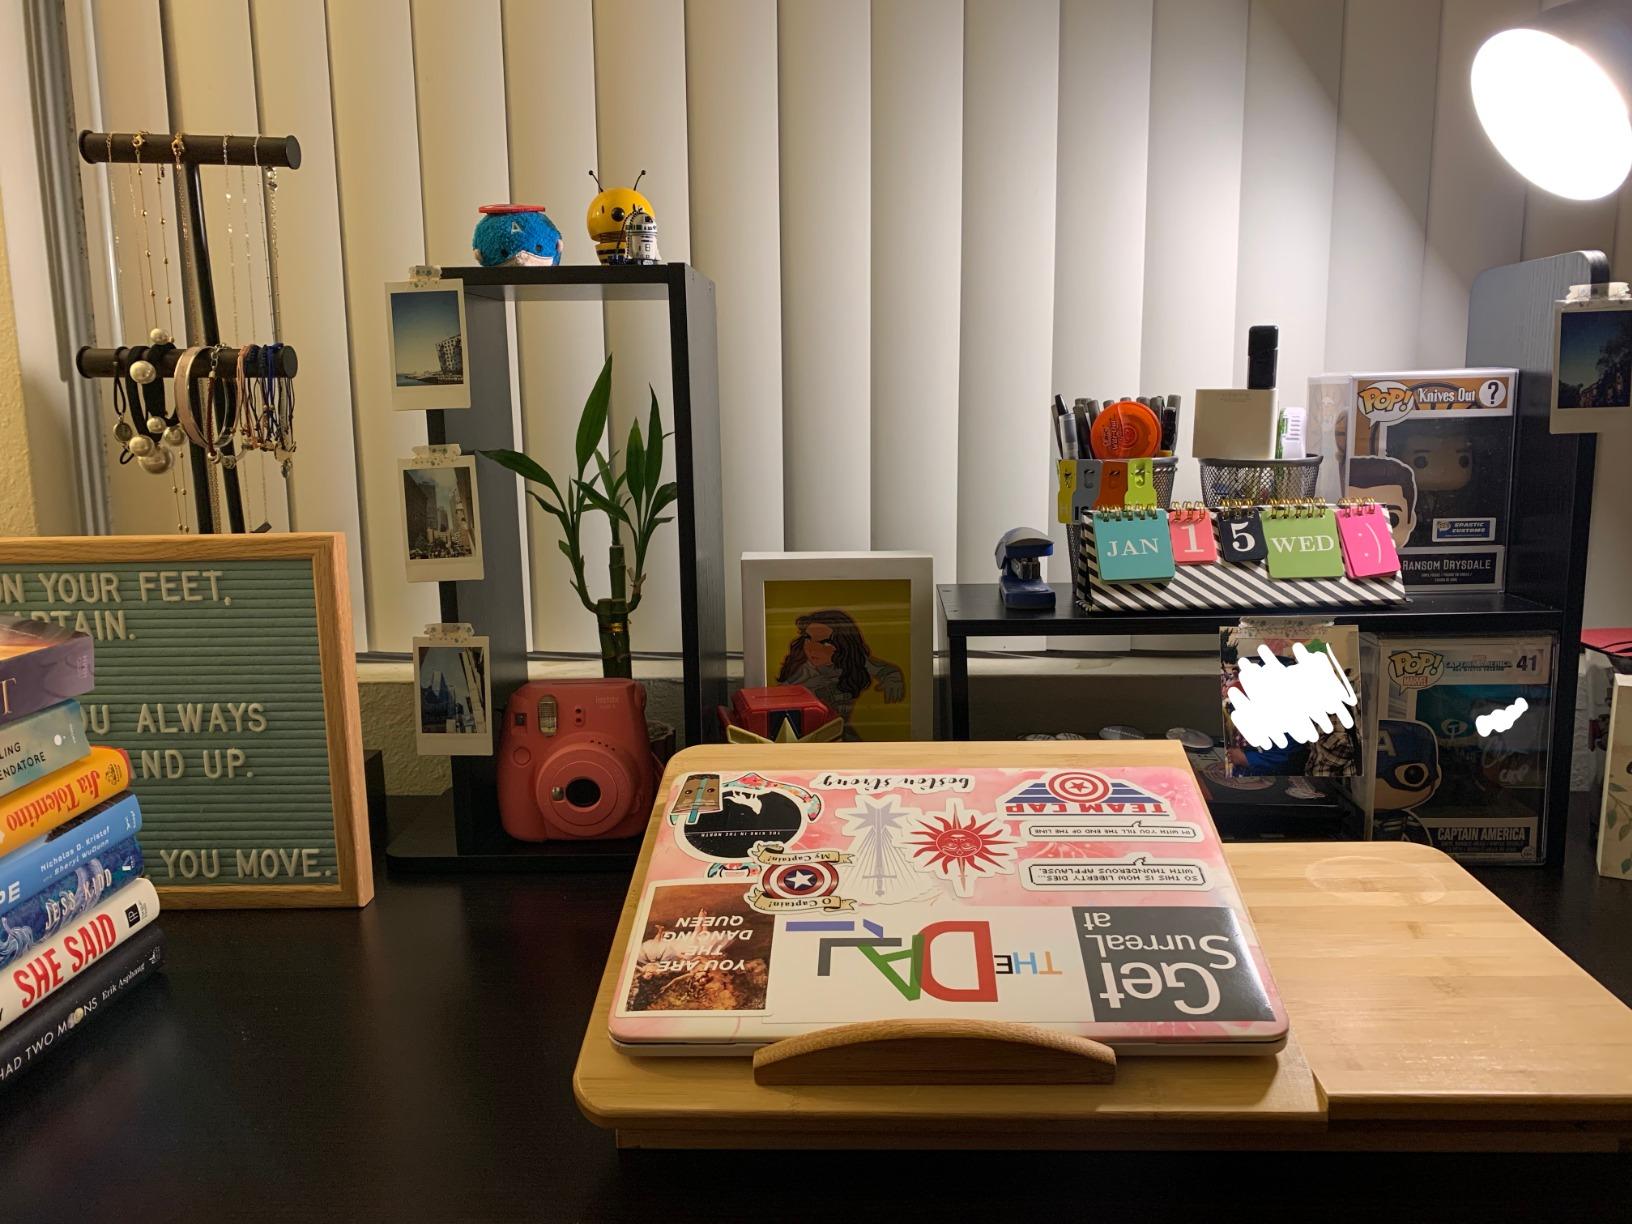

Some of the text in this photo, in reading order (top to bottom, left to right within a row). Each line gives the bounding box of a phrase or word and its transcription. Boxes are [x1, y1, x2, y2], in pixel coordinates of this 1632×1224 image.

[1358, 387, 1413, 415] POP!
[1418, 388, 1455, 402] Knives
[1458, 388, 1476, 402] Out
[1107, 538, 1159, 557] JAN
[1180, 524, 1205, 553] 1
[1230, 521, 1256, 552] 5
[1271, 535, 1335, 553] WED
[1402, 559, 1491, 571] RANSOM DRYSDALE
[0, 569, 232, 606] N YOUR FEET.
[1388, 651, 1444, 678] POP!
[1516, 655, 1537, 671] 41
[137, 703, 267, 733] ALWAYS
[131, 749, 186, 780] ND
[203, 747, 254, 780] UP.
[76, 770, 101, 799] Jia
[821, 775, 969, 791] boston strong
[6, 783, 80, 831] Tolentino
[1005, 803, 1167, 813] TEAM CAP
[1437, 827, 1526, 841] CAPTAIN AMERICA
[40, 849, 75, 873] Nicholas
[160, 849, 220, 880] YOU
[236, 848, 333, 880] MOVE.
[45, 868, 112, 930] JESS KIDD
[768, 900, 818, 908] Captain!
[675, 915, 744, 928] QUEEN
[1083, 912, 1111, 930] at
[663, 929, 753, 942] DANCING
[12, 947, 64, 1009] SHE
[63, 913, 117, 973] SAID
[682, 945, 724, 956] THE
[657, 959, 746, 972] YOU ARE
[993, 951, 1063, 975] THE
[102, 984, 117, 1001] Erik
[1100, 962, 1221, 1015] Get
[25, 1031, 54, 1061] TWO
